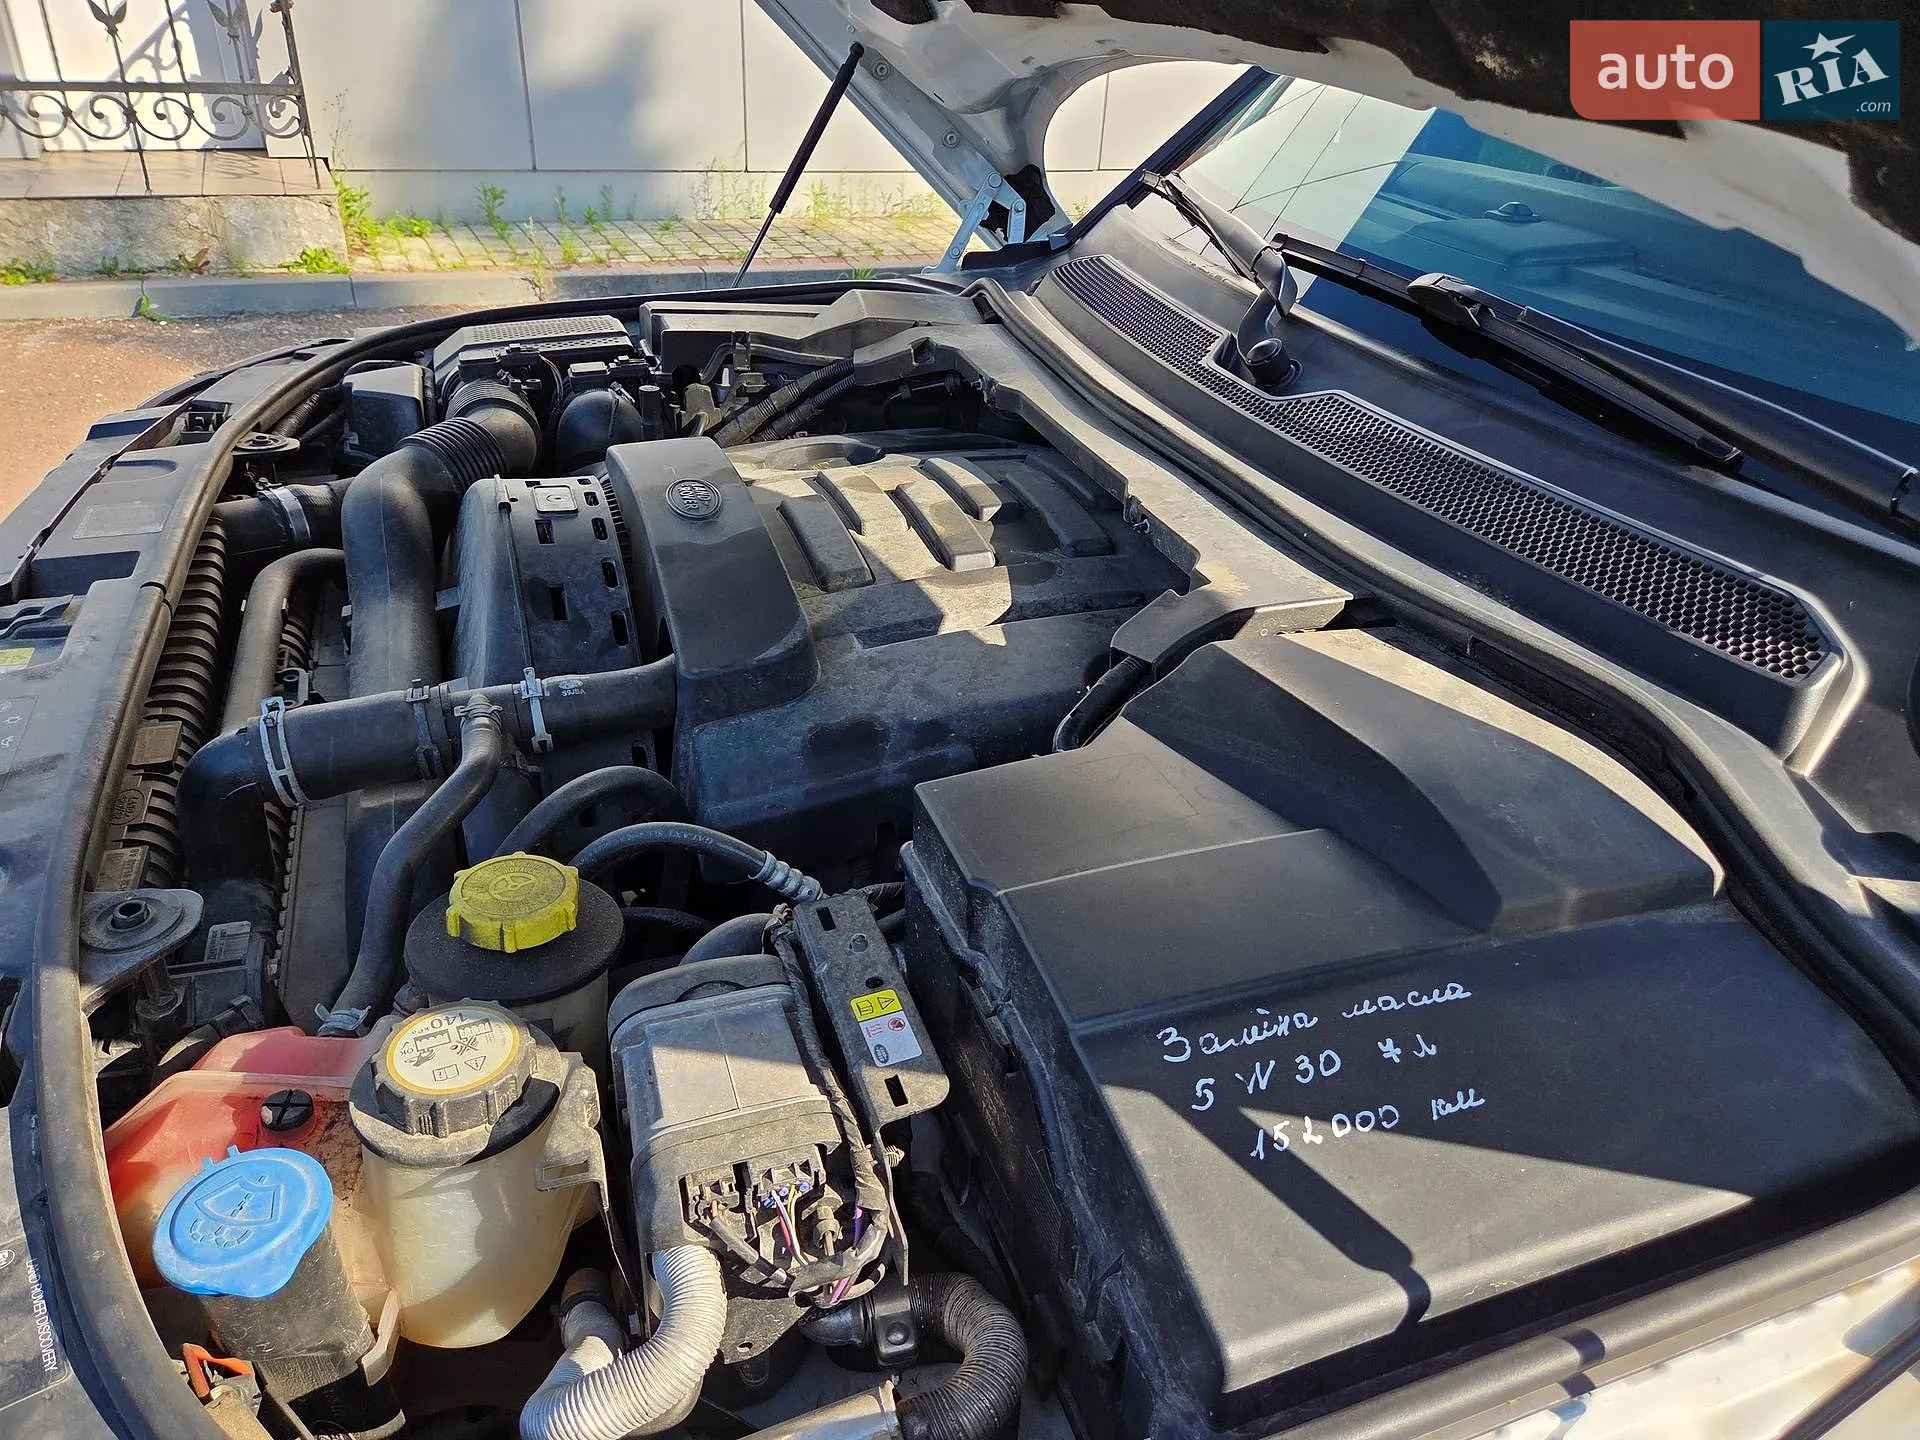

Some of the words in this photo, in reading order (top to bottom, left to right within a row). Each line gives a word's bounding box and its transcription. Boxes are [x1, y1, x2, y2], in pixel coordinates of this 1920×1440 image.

[677, 485, 699, 510] ROVER
[691, 482, 711, 502] LAND
[1342, 982, 1473, 1019] масла
[430, 1012, 468, 1029] 140
[400, 1047, 414, 1056] OK
[1377, 1037, 1401, 1064] 7
[1431, 1088, 1486, 1121] км
[26, 1259, 41, 1283] LAND
[31, 1283, 47, 1317] ROVER
[36, 1316, 58, 1372] DISCOVERY
